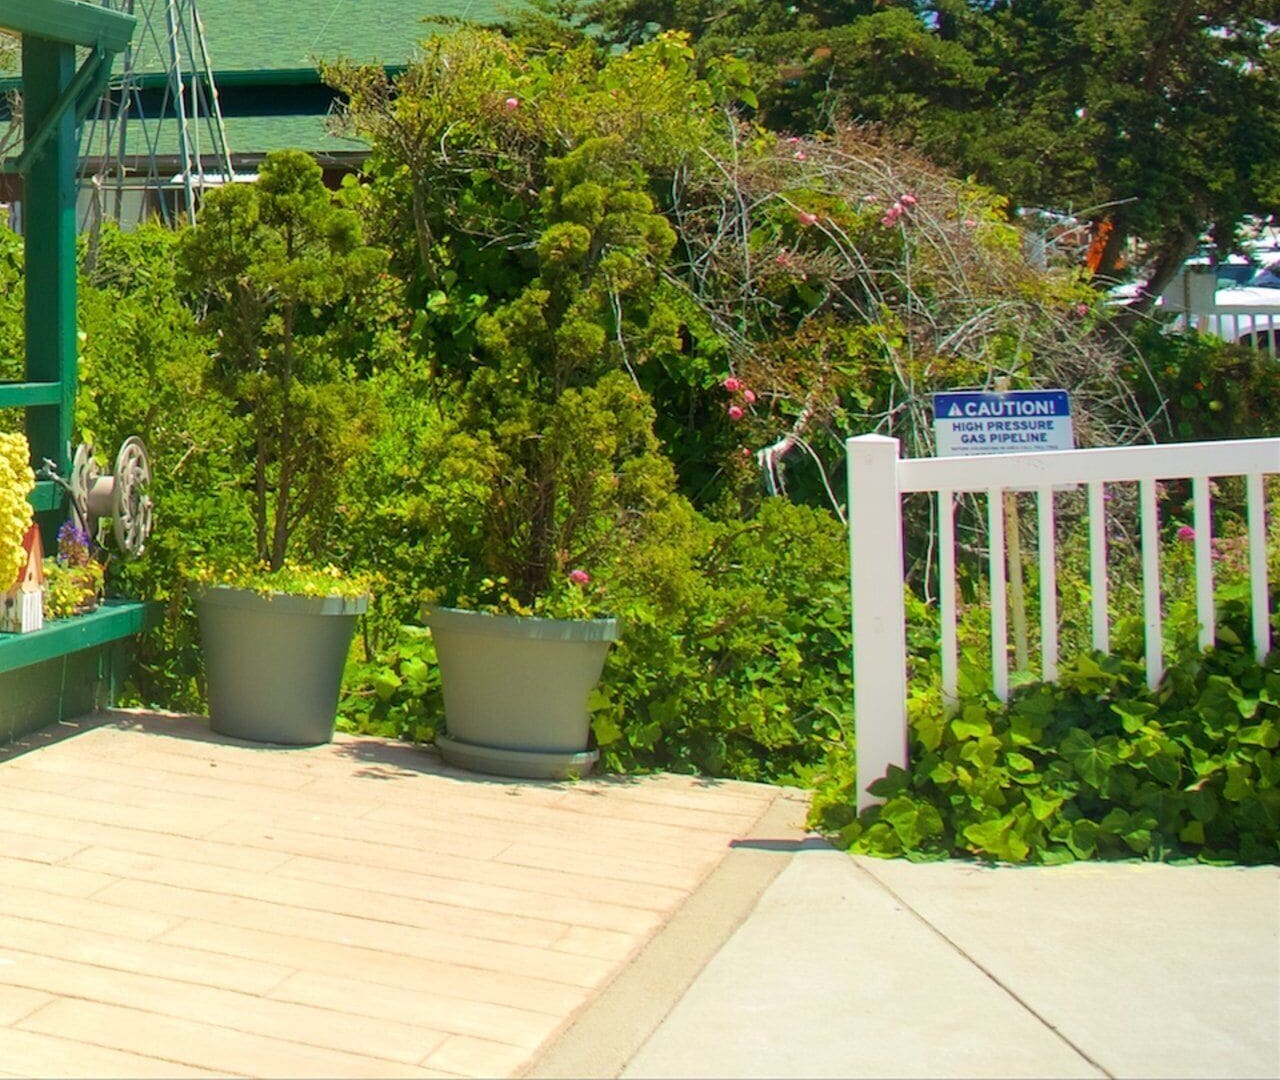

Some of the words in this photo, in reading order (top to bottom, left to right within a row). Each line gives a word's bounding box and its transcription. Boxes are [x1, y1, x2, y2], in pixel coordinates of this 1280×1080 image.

[965, 401, 1056, 416] CAUTION!
[952, 422, 983, 432] HIGH
[987, 420, 1054, 431] PRESSURE
[961, 434, 986, 444] GAS
[990, 432, 1048, 443] PIPELINE
